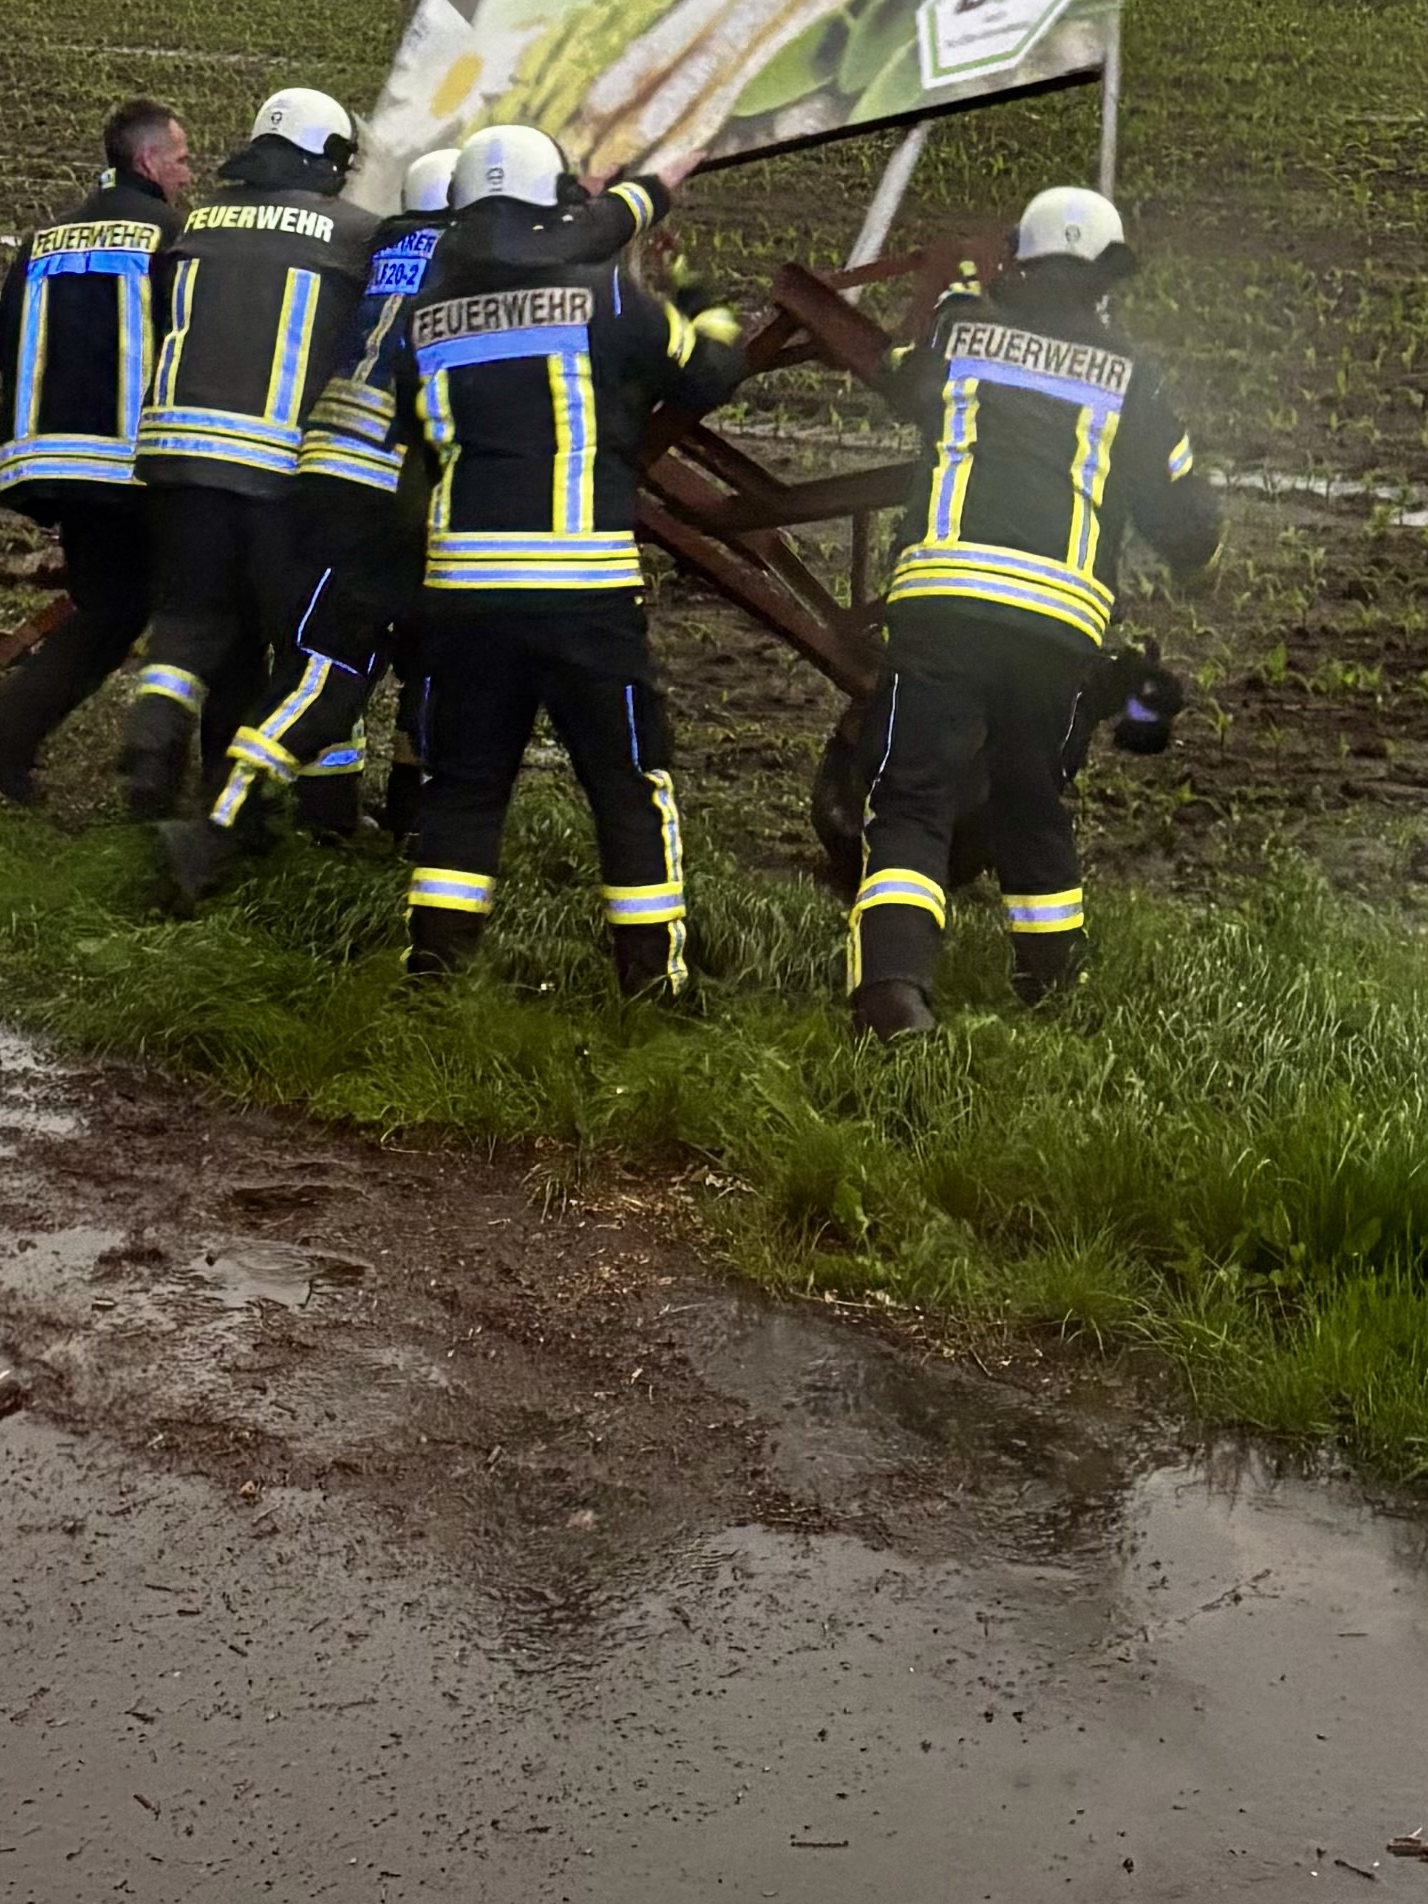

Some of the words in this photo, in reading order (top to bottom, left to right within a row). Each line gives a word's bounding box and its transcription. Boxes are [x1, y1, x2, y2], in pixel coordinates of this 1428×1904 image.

[35, 223, 158, 252] FEUERWEHR
[184, 205, 334, 242] FEUERWEHR
[419, 292, 588, 343] FEUERWEHR
[951, 324, 1126, 389] FEUERWEHR
